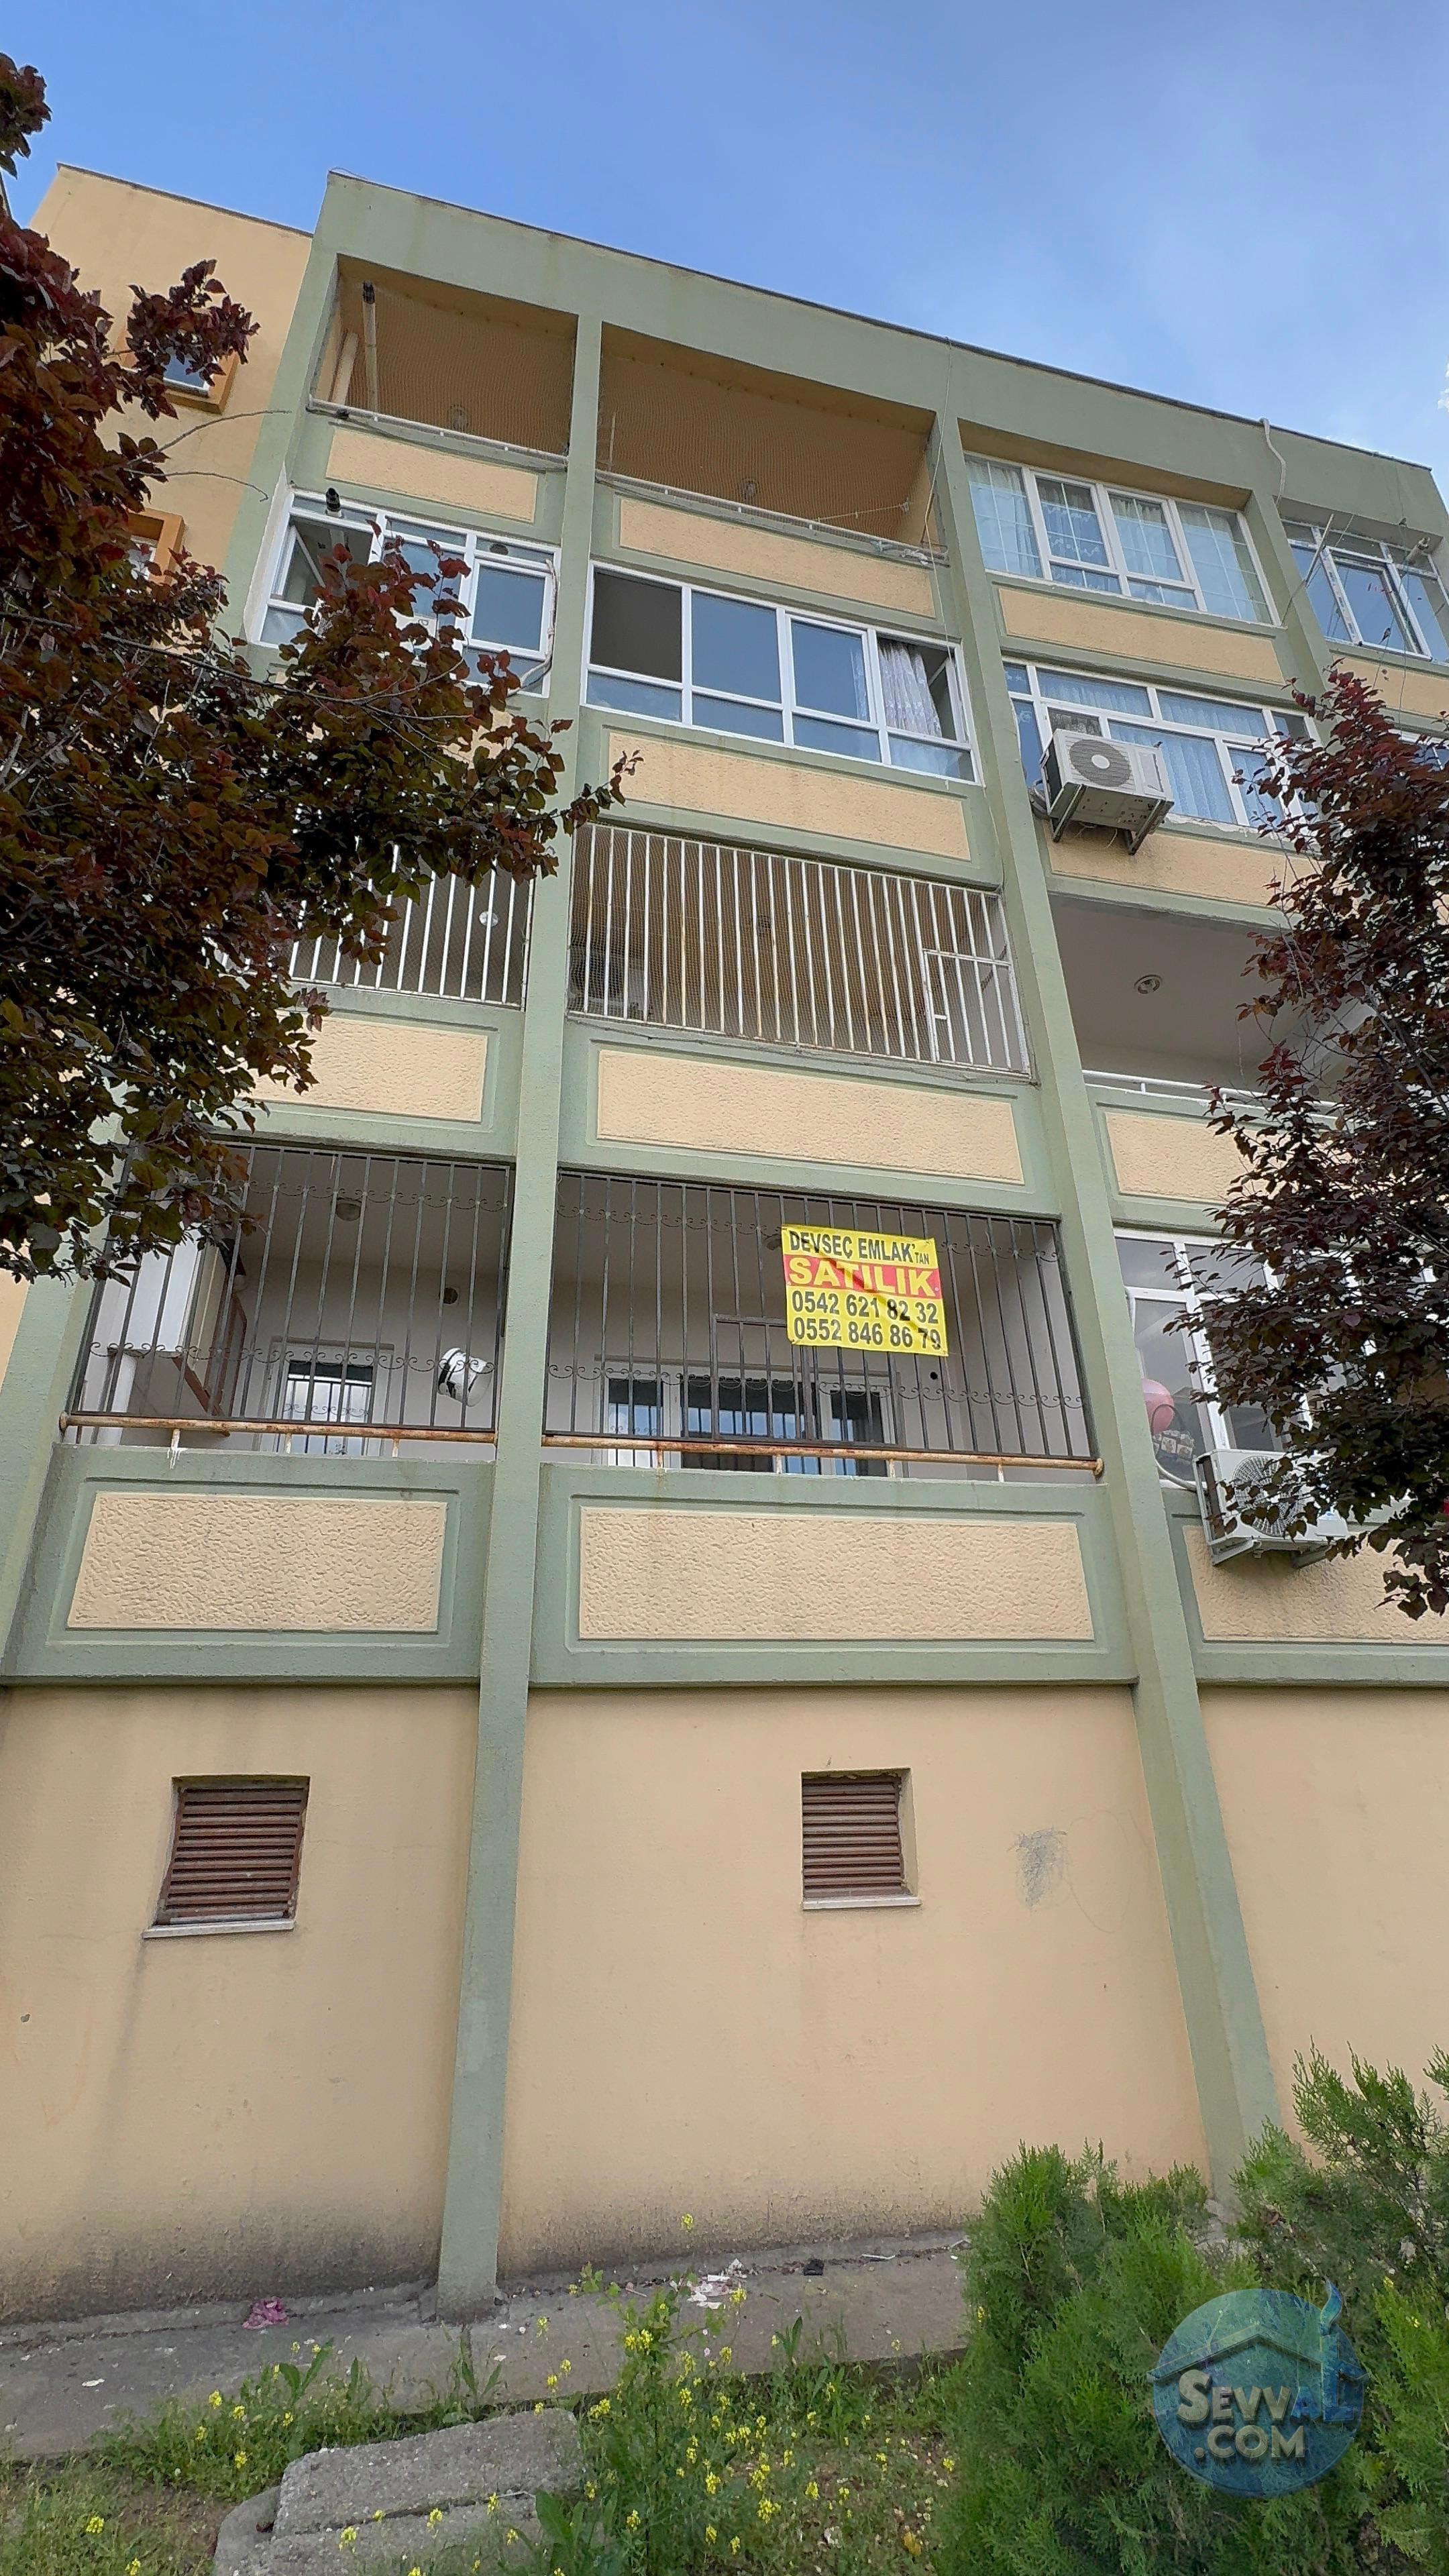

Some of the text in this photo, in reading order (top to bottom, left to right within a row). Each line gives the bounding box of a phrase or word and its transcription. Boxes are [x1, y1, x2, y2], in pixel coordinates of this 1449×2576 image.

[790, 1231, 853, 1258] DEVSEÇ
[789, 1257, 934, 1297] SATILIK
[792, 1290, 938, 1324] 0542 621 82 32
[794, 1318, 941, 1350] 0552 846 86 79
